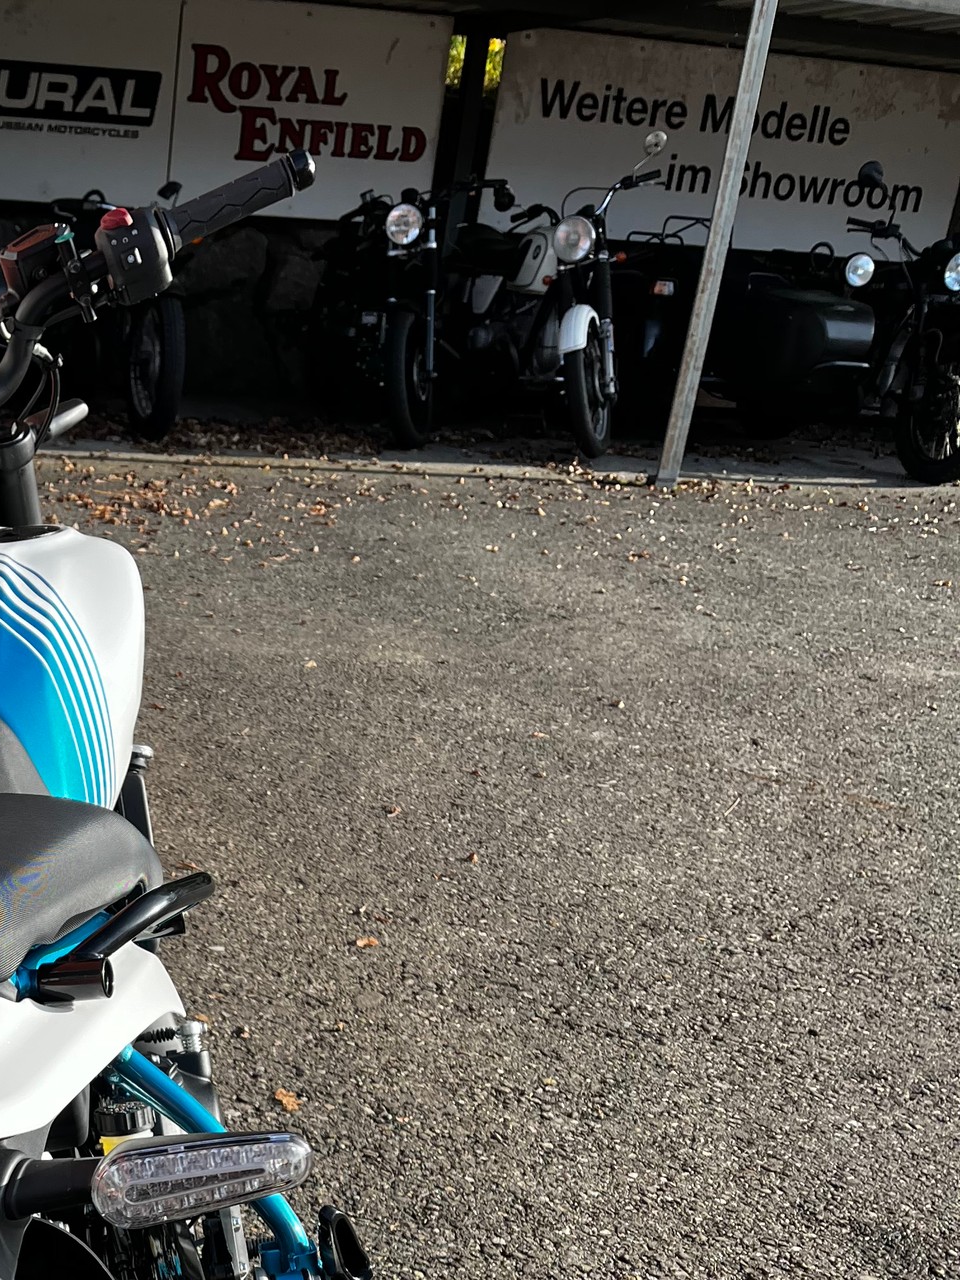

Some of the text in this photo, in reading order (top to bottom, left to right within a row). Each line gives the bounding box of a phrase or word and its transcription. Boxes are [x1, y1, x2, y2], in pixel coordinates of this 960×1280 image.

[187, 43, 348, 113] ROYAL
[46, 122, 140, 140] MOTORCYCLES
[234, 105, 427, 163] ENFIELD
[540, 77, 851, 146] Weitere Mdelle
[664, 153, 711, 195] im
